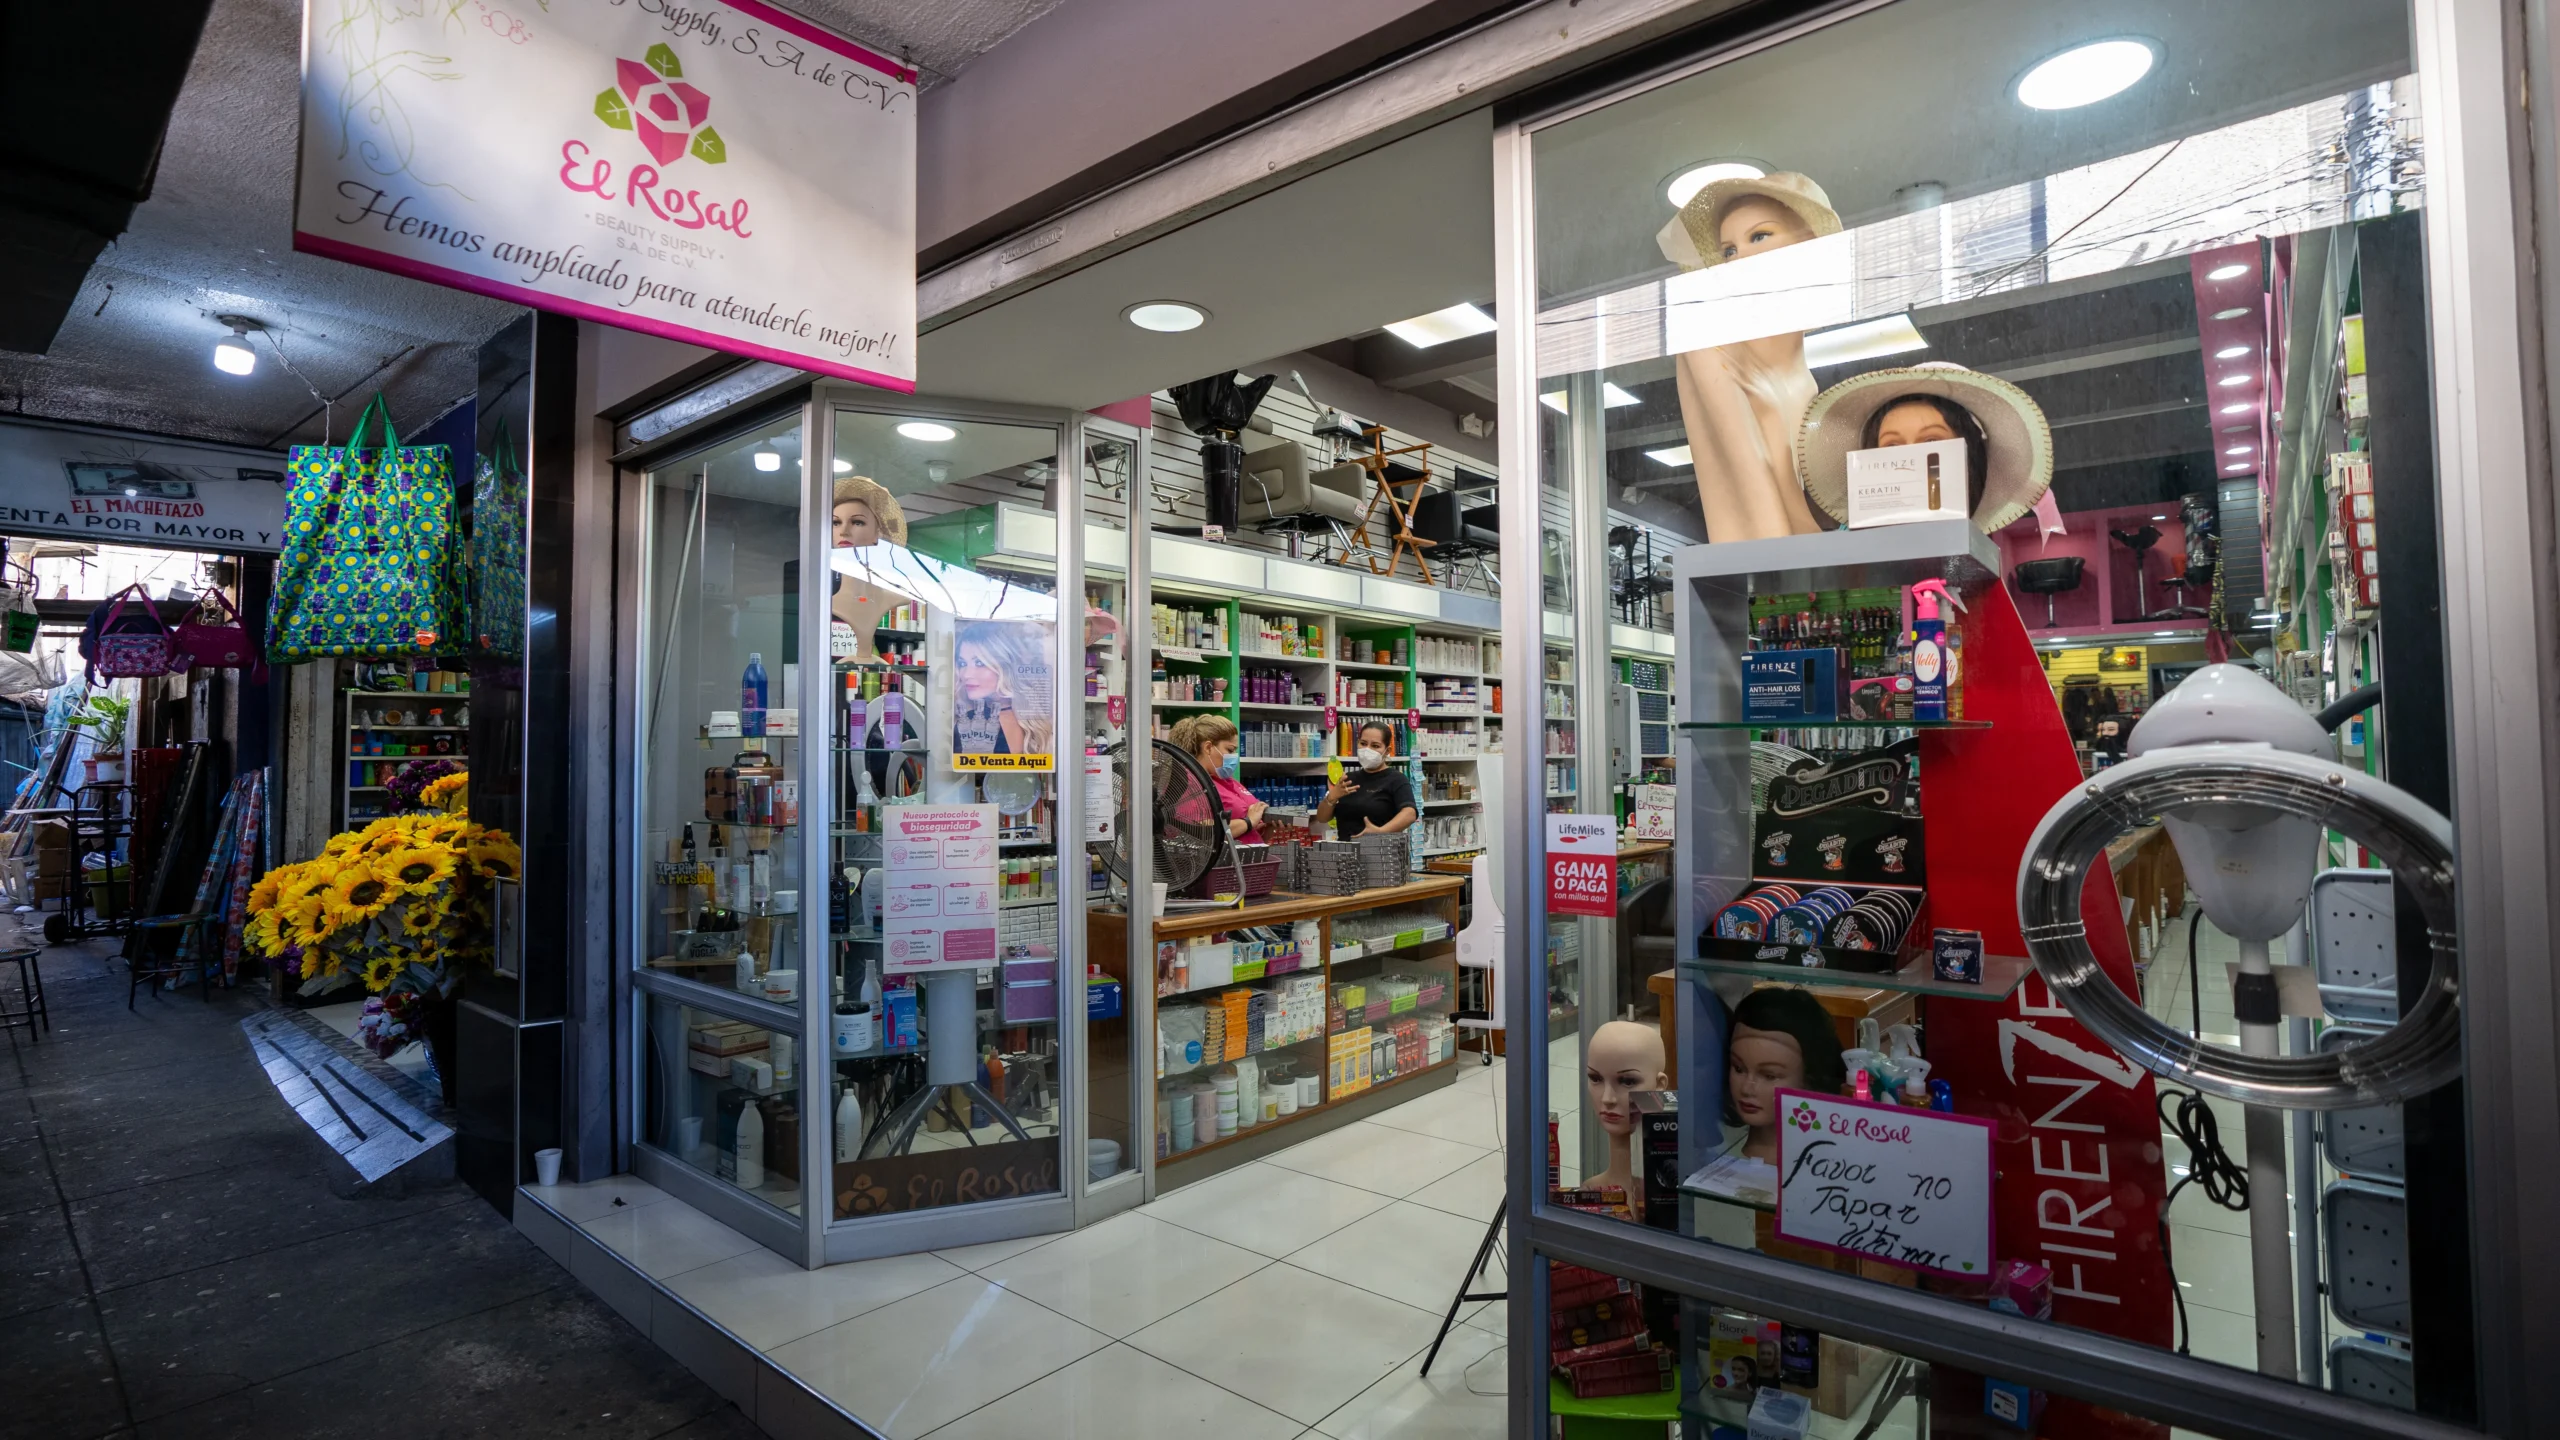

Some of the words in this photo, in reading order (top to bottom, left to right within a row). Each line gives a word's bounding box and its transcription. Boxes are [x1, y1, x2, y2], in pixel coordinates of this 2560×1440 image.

[813, 62, 836, 87] de
[560, 139, 616, 200] El
[626, 163, 753, 239] Rosal
[595, 212, 656, 243] BEAUTY
[660, 233, 716, 260] SUPPLY
[647, 246, 667, 262] DE
[336, 180, 484, 254] Hemos
[492, 244, 629, 292] ampliado
[622, 273, 698, 309] para
[704, 295, 812, 339] atenderle
[818, 325, 897, 360] mejor!!
[1860, 459, 1916, 470] FIRENZE
[1858, 486, 1901, 496] KERATIN
[70, 499, 99, 515] EL
[104, 499, 205, 518] MACHETAZO
[85, 515, 141, 532] POR
[154, 522, 245, 542] MAYOR
[257, 531, 271, 544] Y
[1750, 662, 1796, 671] FIRENZE
[1915, 652, 1938, 673] Nelly
[1018, 666, 1047, 675] OPLEX
[1749, 685, 1783, 693] ANTI-HAIR
[959, 755, 976, 766] De
[980, 755, 1015, 766] Venta
[1018, 755, 1047, 768] Aquí
[903, 811, 929, 820] Nuevo
[930, 810, 968, 820] protocolo
[970, 810, 980, 818] de
[910, 821, 971, 833] bioseguridad
[1559, 824, 1605, 836] LifeMiles
[1554, 861, 1608, 880] GANA
[1554, 878, 1565, 890] O
[1568, 879, 1608, 893] PAGA
[1568, 892, 1589, 902] millas
[1590, 894, 1607, 904] aquí
[1828, 1112, 1850, 1137] El
[1855, 1117, 1912, 1144] Rosal
